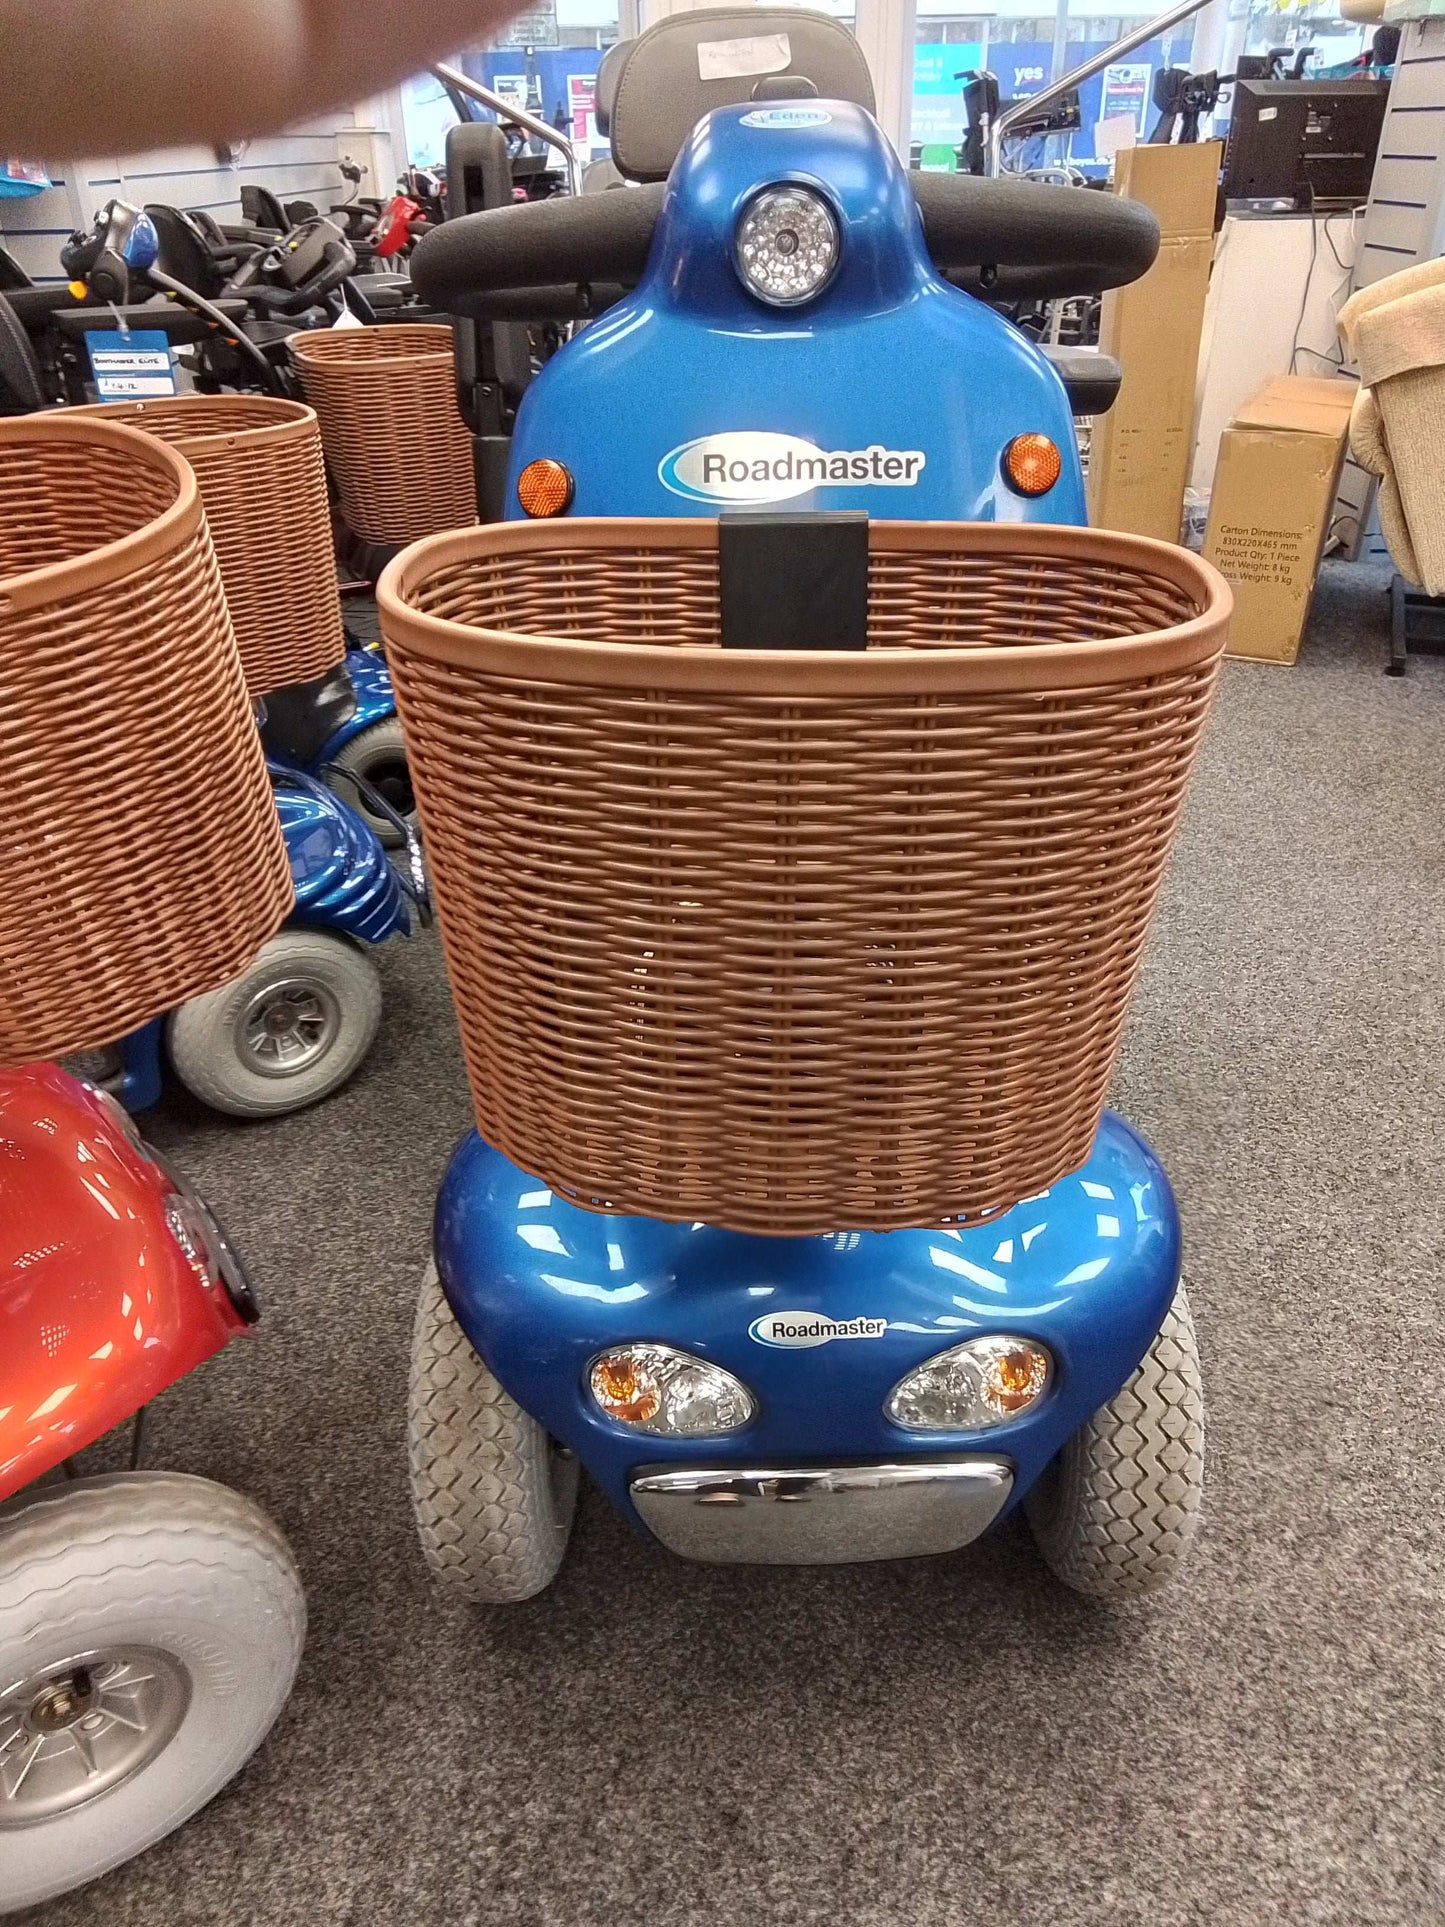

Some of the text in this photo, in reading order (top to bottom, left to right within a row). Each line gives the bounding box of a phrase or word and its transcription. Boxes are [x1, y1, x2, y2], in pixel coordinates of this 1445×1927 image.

[769, 112, 818, 121] Eden
[703, 451, 919, 484] Roadmaster
[1220, 525, 1303, 540] Carton Dimensions:
[1280, 542, 1297, 550] mm
[1215, 547, 1248, 558] Product
[1250, 550, 1267, 560] Qty:
[1277, 552, 1300, 562] Piece
[1220, 559, 1290, 574] Net Weight: 8 kg
[1220, 571, 1292, 586] ross Weight: 9 kg
[772, 1321, 884, 1338] Roadmaster
